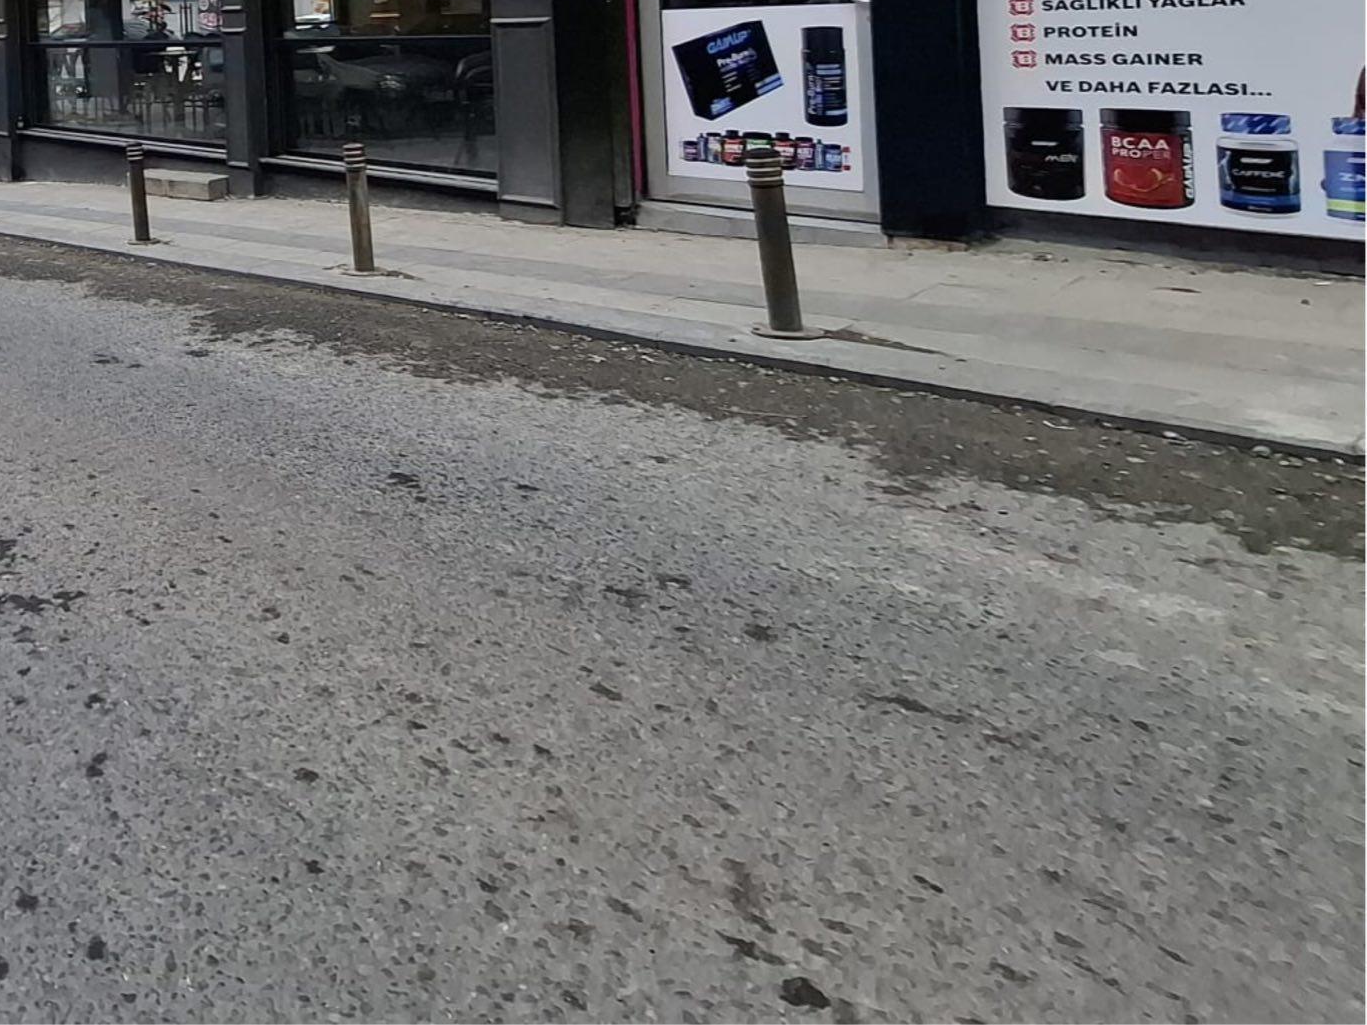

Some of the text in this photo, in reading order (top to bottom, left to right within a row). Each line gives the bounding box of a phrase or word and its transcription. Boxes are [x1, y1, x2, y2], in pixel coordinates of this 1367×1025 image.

[1043, 22, 1138, 38] PROTEİN
[1044, 54, 1203, 66] MASS GAINER
[1045, 80, 1273, 97] VE DAHA FAZLASI...
[1111, 136, 1169, 150] BCAA
[1112, 148, 1171, 160] PROPER
